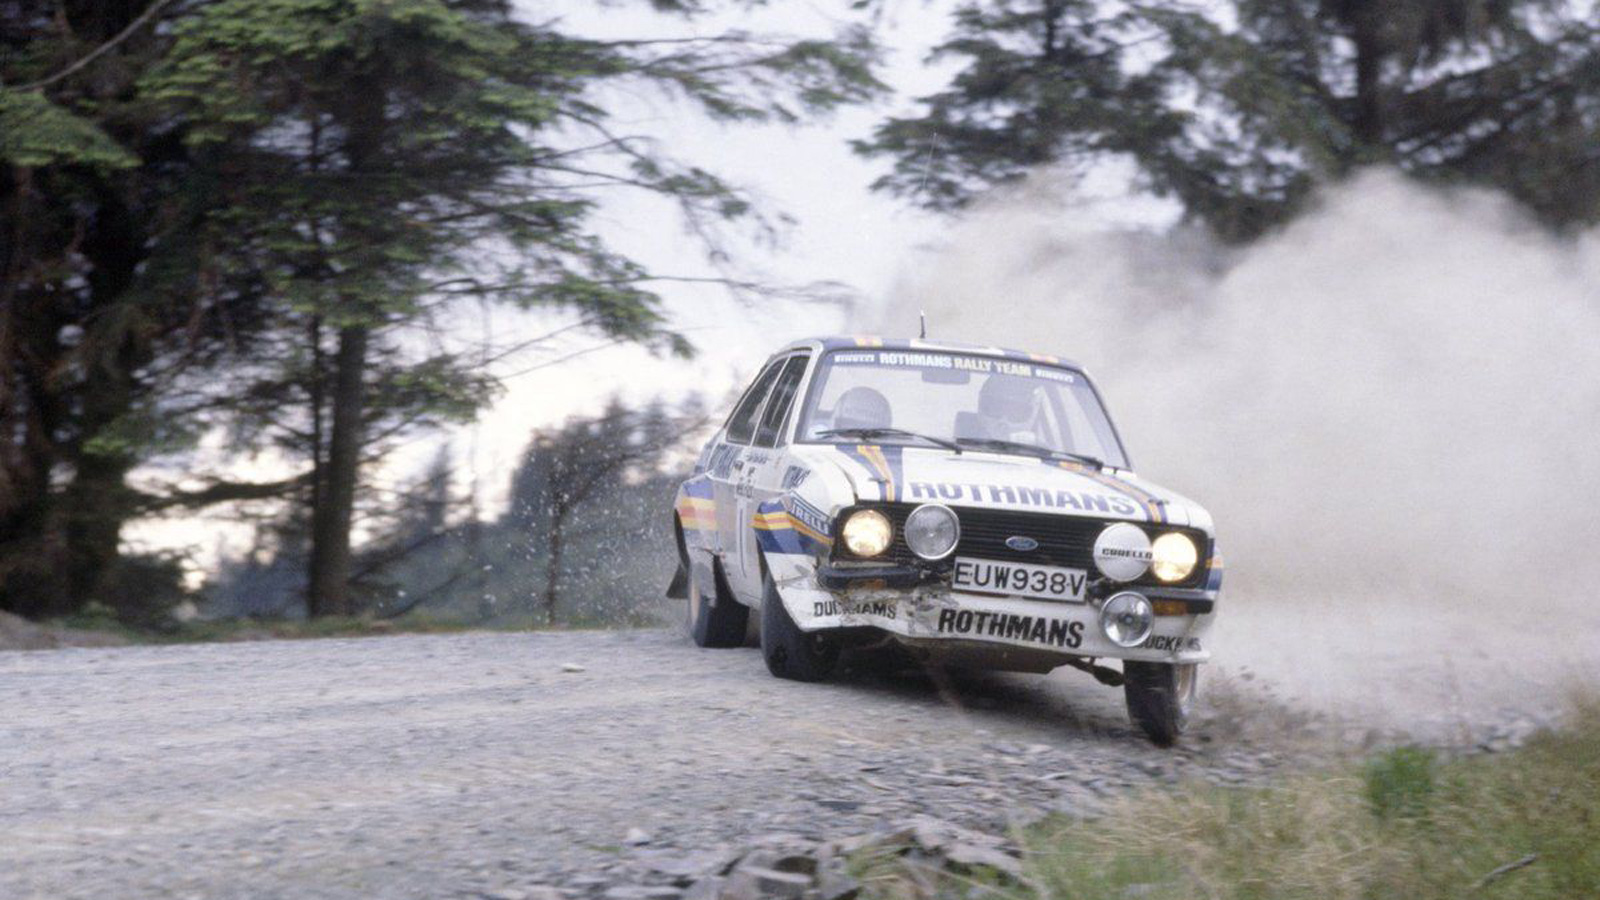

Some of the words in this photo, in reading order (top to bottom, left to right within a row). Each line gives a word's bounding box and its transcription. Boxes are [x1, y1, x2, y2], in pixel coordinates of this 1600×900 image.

[880, 352, 952, 369] ROTHMANS
[953, 357, 992, 372] RALLY
[993, 360, 1032, 377] TEAM
[909, 481, 1136, 516] ROTHMANS
[954, 562, 1085, 596] EUW938V
[938, 608, 1085, 648] ROTHMANS
